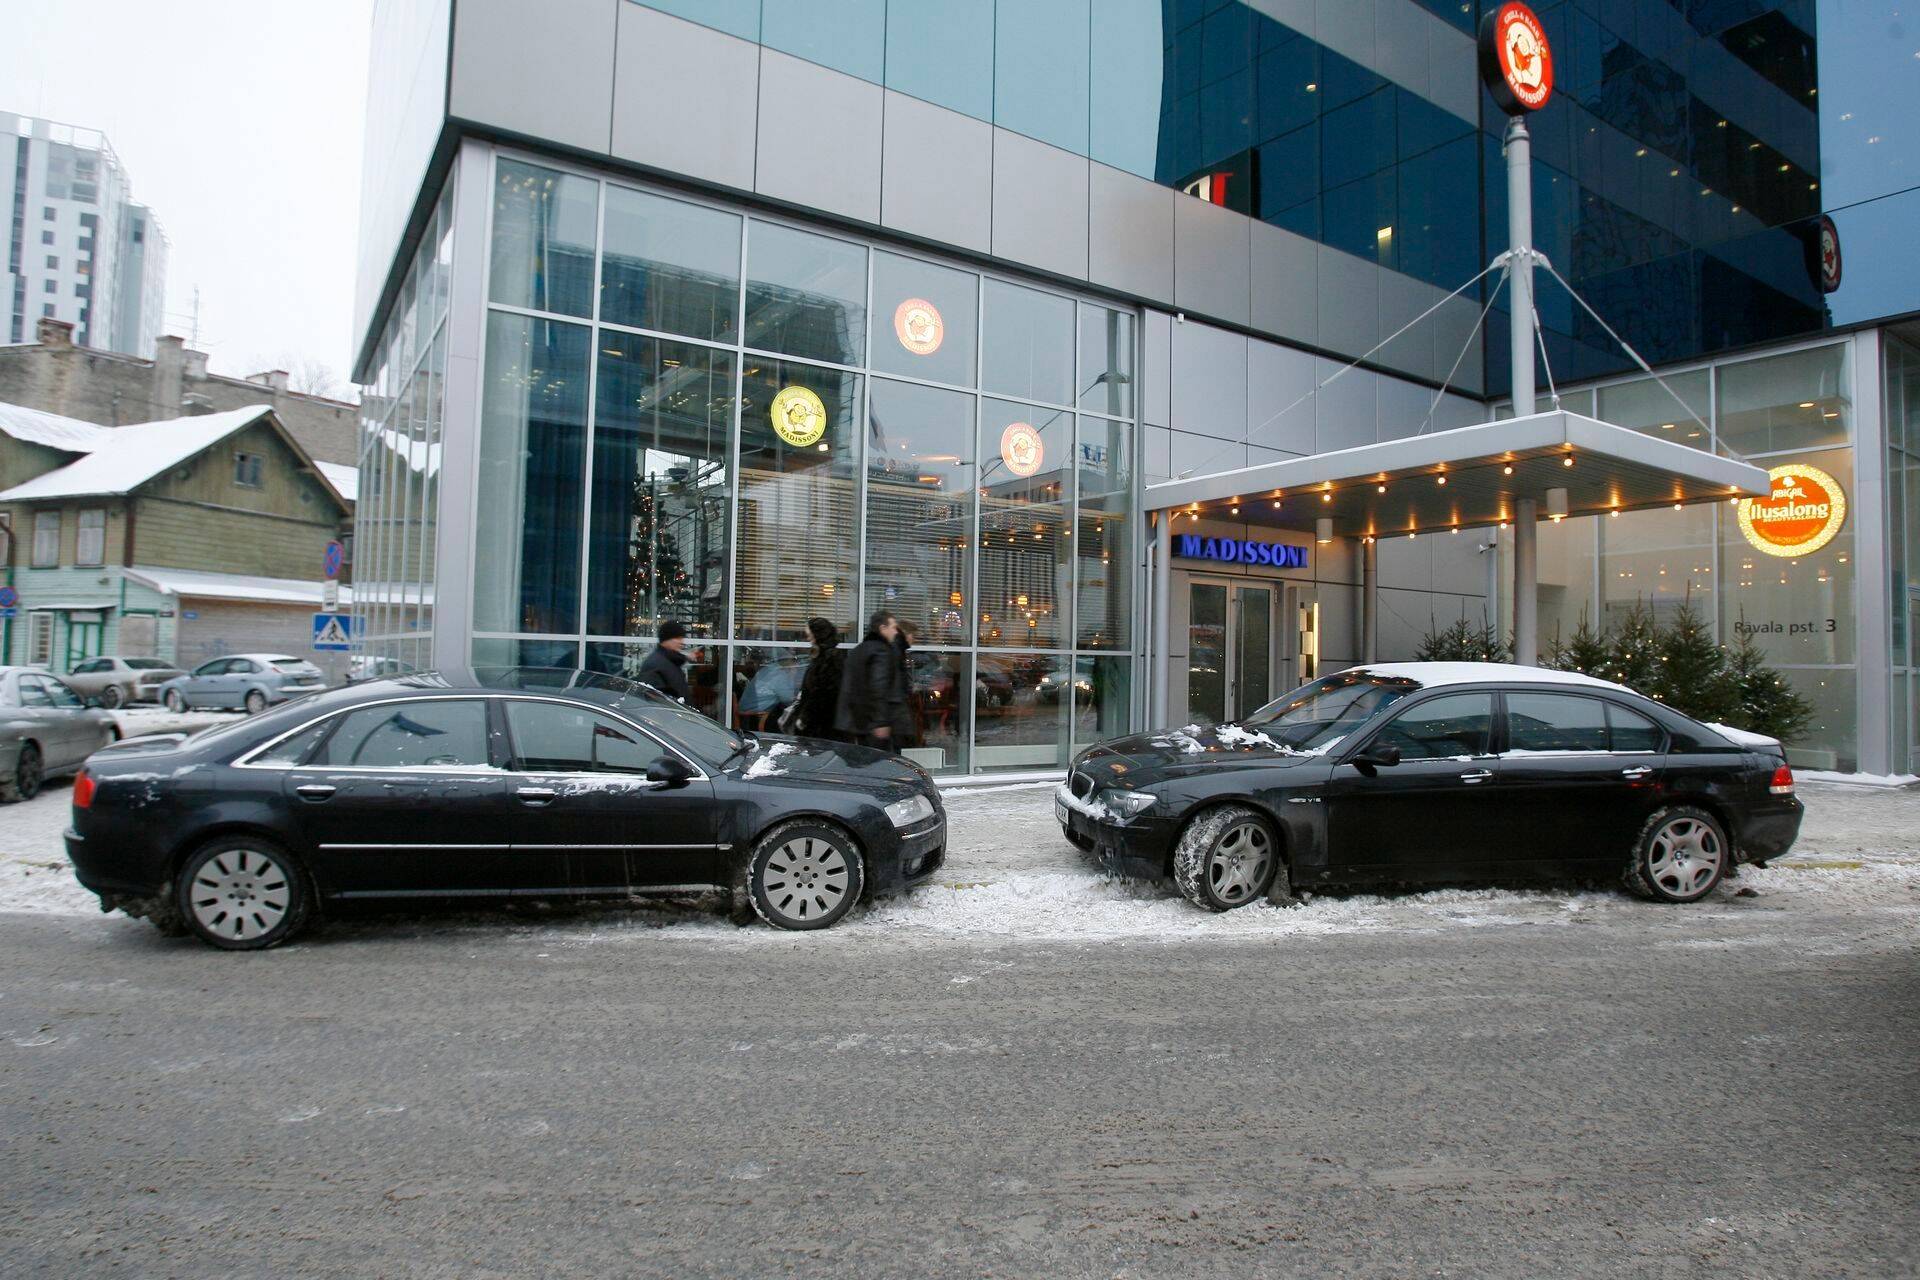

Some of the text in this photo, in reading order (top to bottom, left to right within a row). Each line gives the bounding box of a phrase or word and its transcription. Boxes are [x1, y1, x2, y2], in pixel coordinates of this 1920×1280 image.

[780, 426, 819, 443] MADISSONI
[1181, 533, 1309, 568] MADISSONI
[1789, 621, 1819, 636] pst.
[1825, 618, 1837, 633] 3
